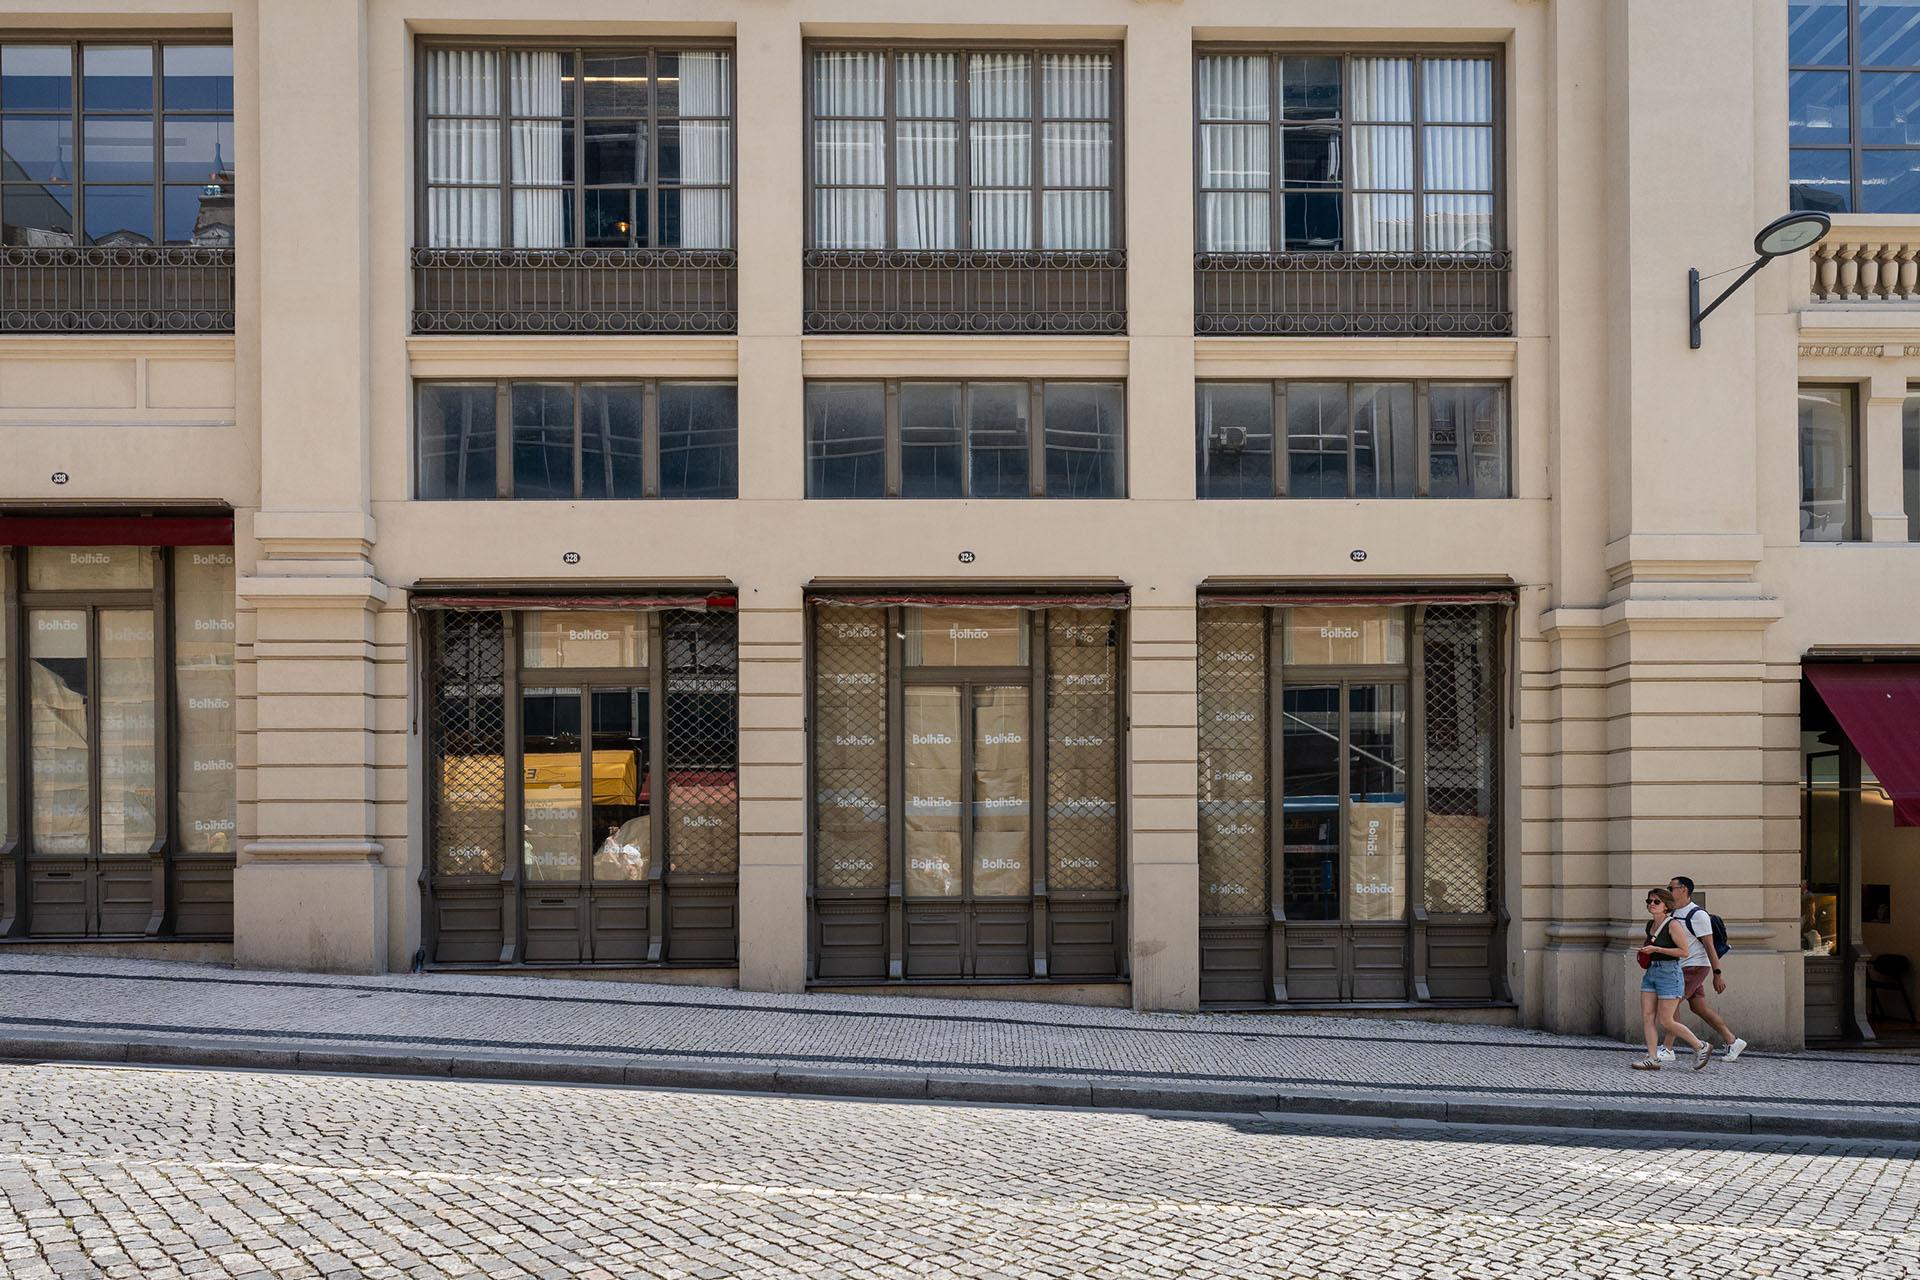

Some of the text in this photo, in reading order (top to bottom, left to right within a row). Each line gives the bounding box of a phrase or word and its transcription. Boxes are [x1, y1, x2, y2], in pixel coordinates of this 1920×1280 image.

[54, 474, 66, 483] 338
[70, 553, 110, 564] Bolhão
[193, 554, 233, 565] Bolhão
[565, 553, 578, 562] 328
[960, 552, 973, 561] 324
[1352, 551, 1365, 560] 322
[38, 619, 78, 631] Bolhão
[194, 619, 235, 631] Bolhão
[569, 630, 609, 641] Bolhão
[950, 629, 989, 639] Bolhão
[1320, 627, 1359, 638] Bolhão
[189, 698, 229, 709] Bolhão
[912, 734, 951, 745] Bolhão
[985, 733, 1021, 745] Bolhão
[194, 760, 234, 771] Bolhão
[913, 796, 951, 808] Bolhão
[985, 796, 1022, 808] Bolhão
[195, 819, 235, 831] Bolhão
[911, 859, 950, 870] Bolhão
[982, 859, 1021, 870] Bolhão
[1356, 883, 1394, 894] Bolhão
